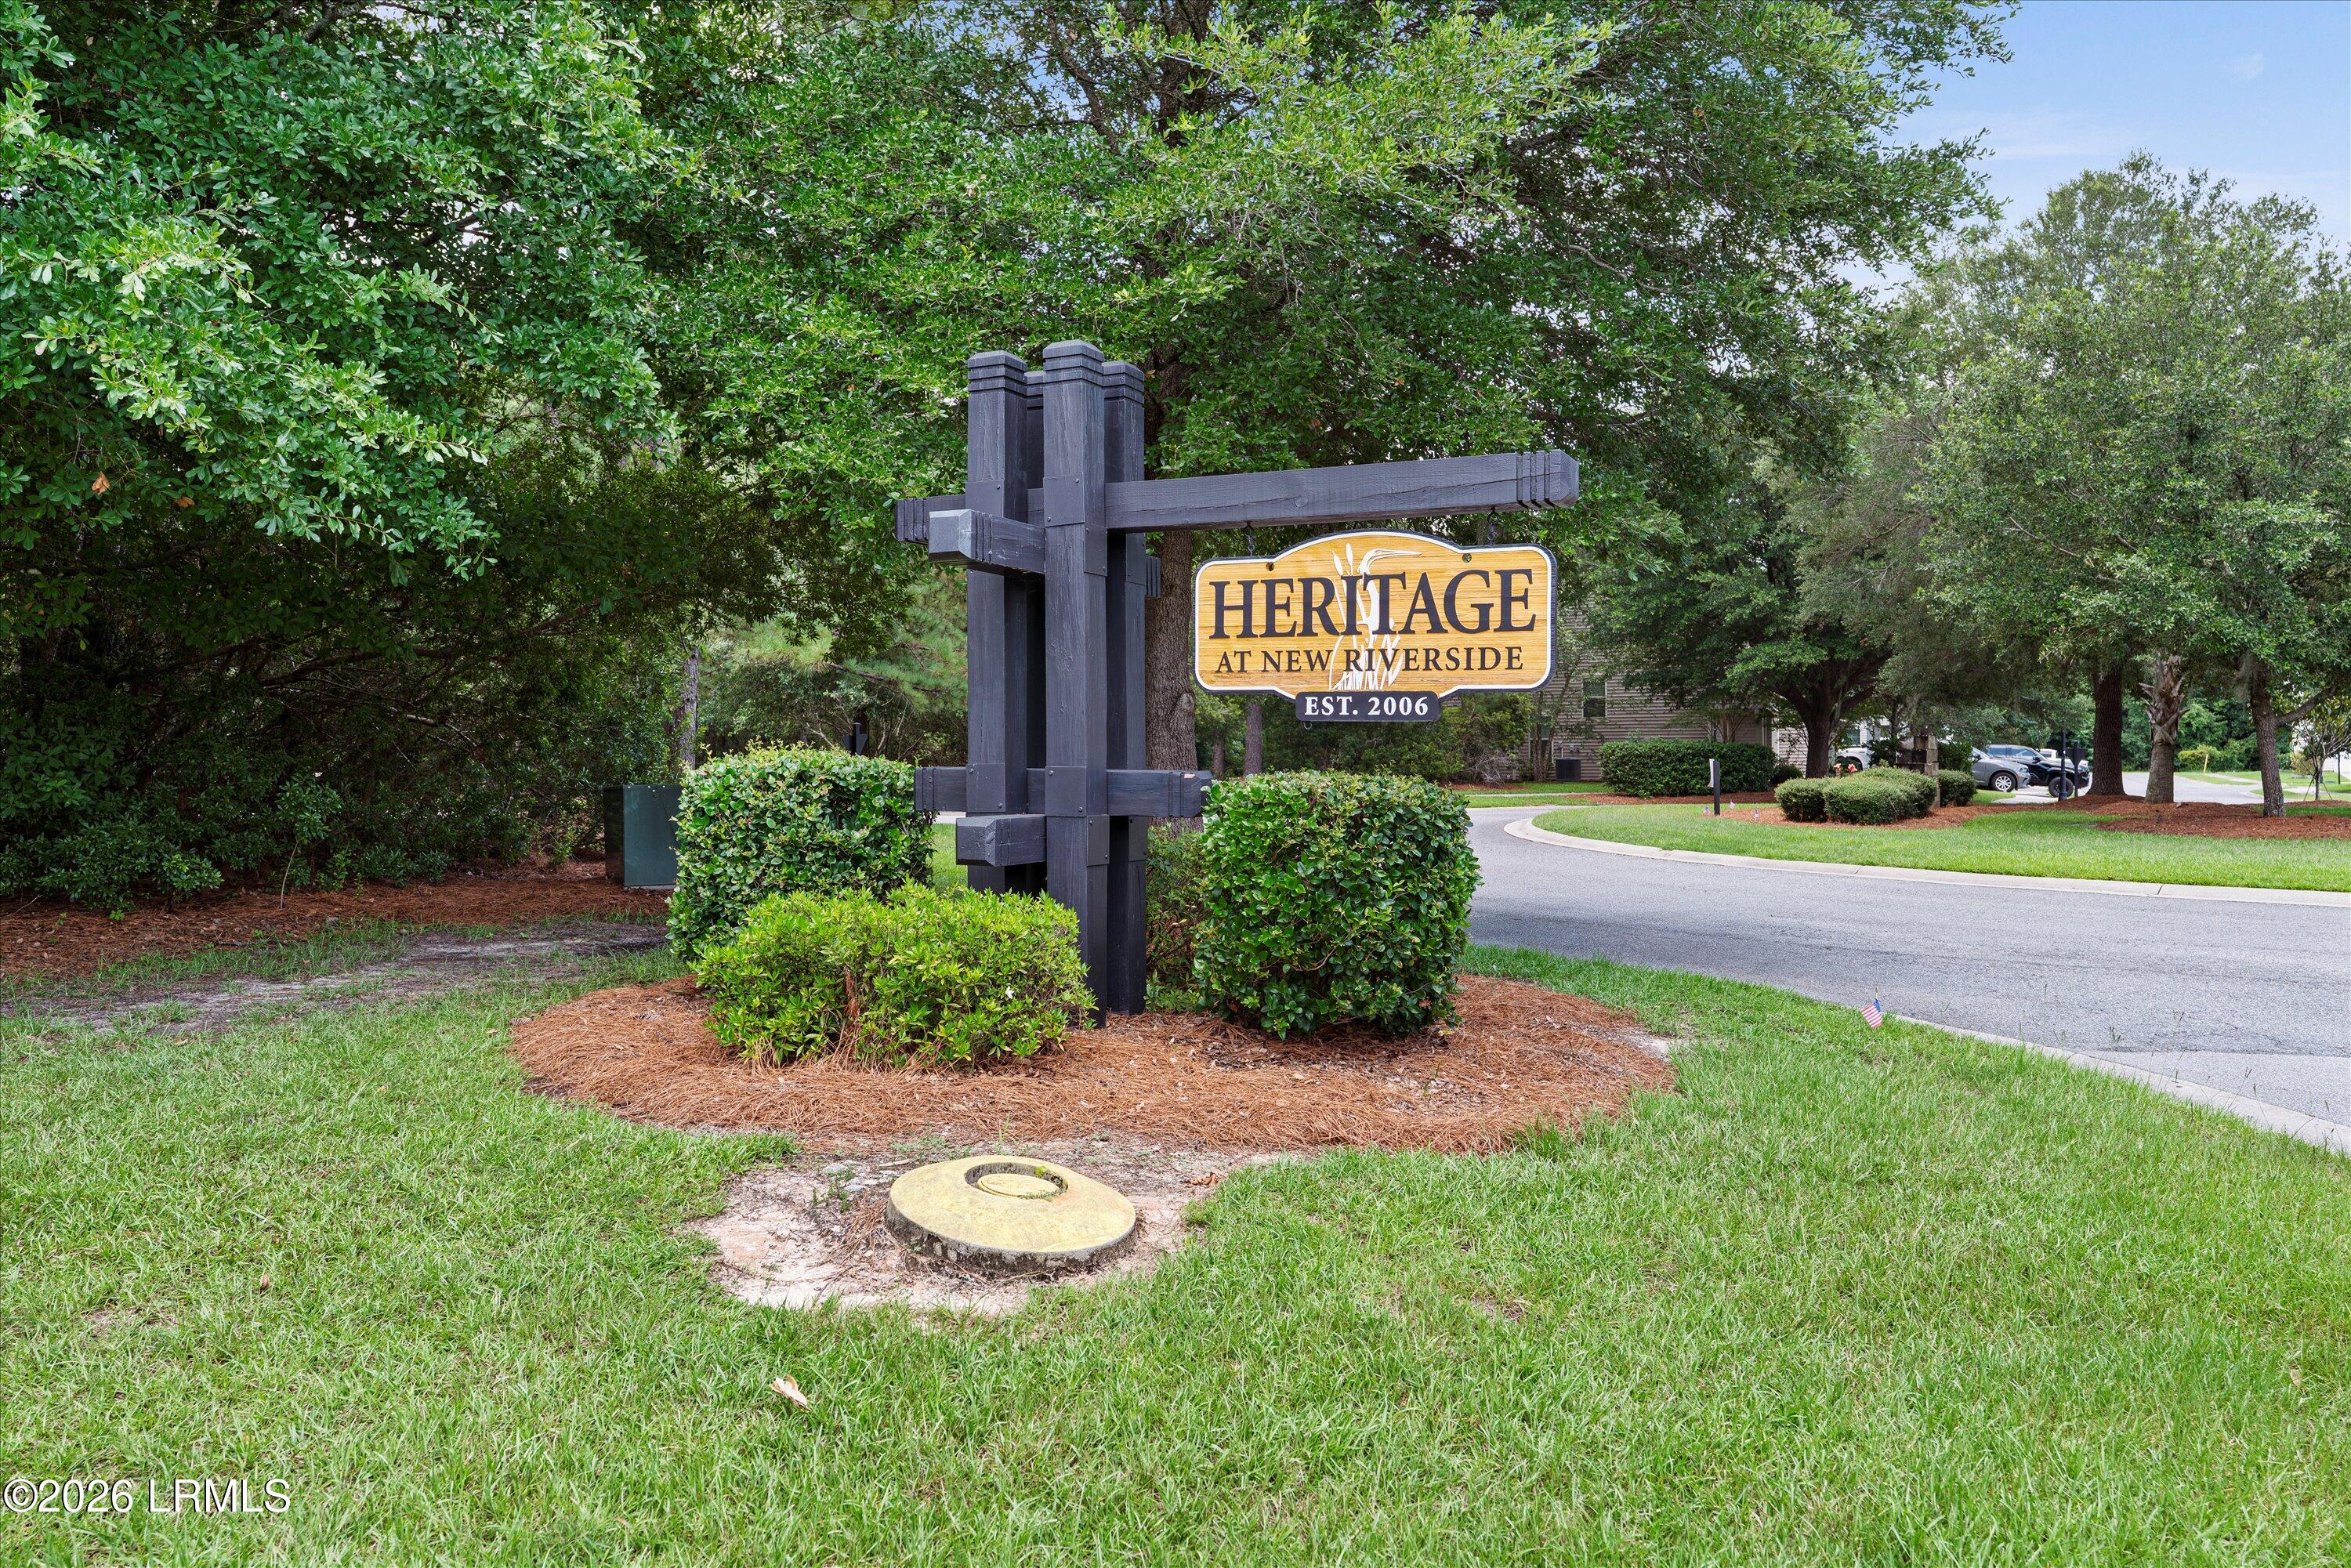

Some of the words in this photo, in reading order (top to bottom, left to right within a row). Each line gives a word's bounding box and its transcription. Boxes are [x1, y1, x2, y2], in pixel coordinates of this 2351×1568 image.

[1209, 569, 1537, 639] HERITAGE
[1215, 650, 1252, 673] AT
[1261, 650, 1333, 673] NEW
[1344, 646, 1524, 672] RIVERSIDE
[1305, 697, 1358, 716] EST.
[1369, 696, 1429, 716] 2006
